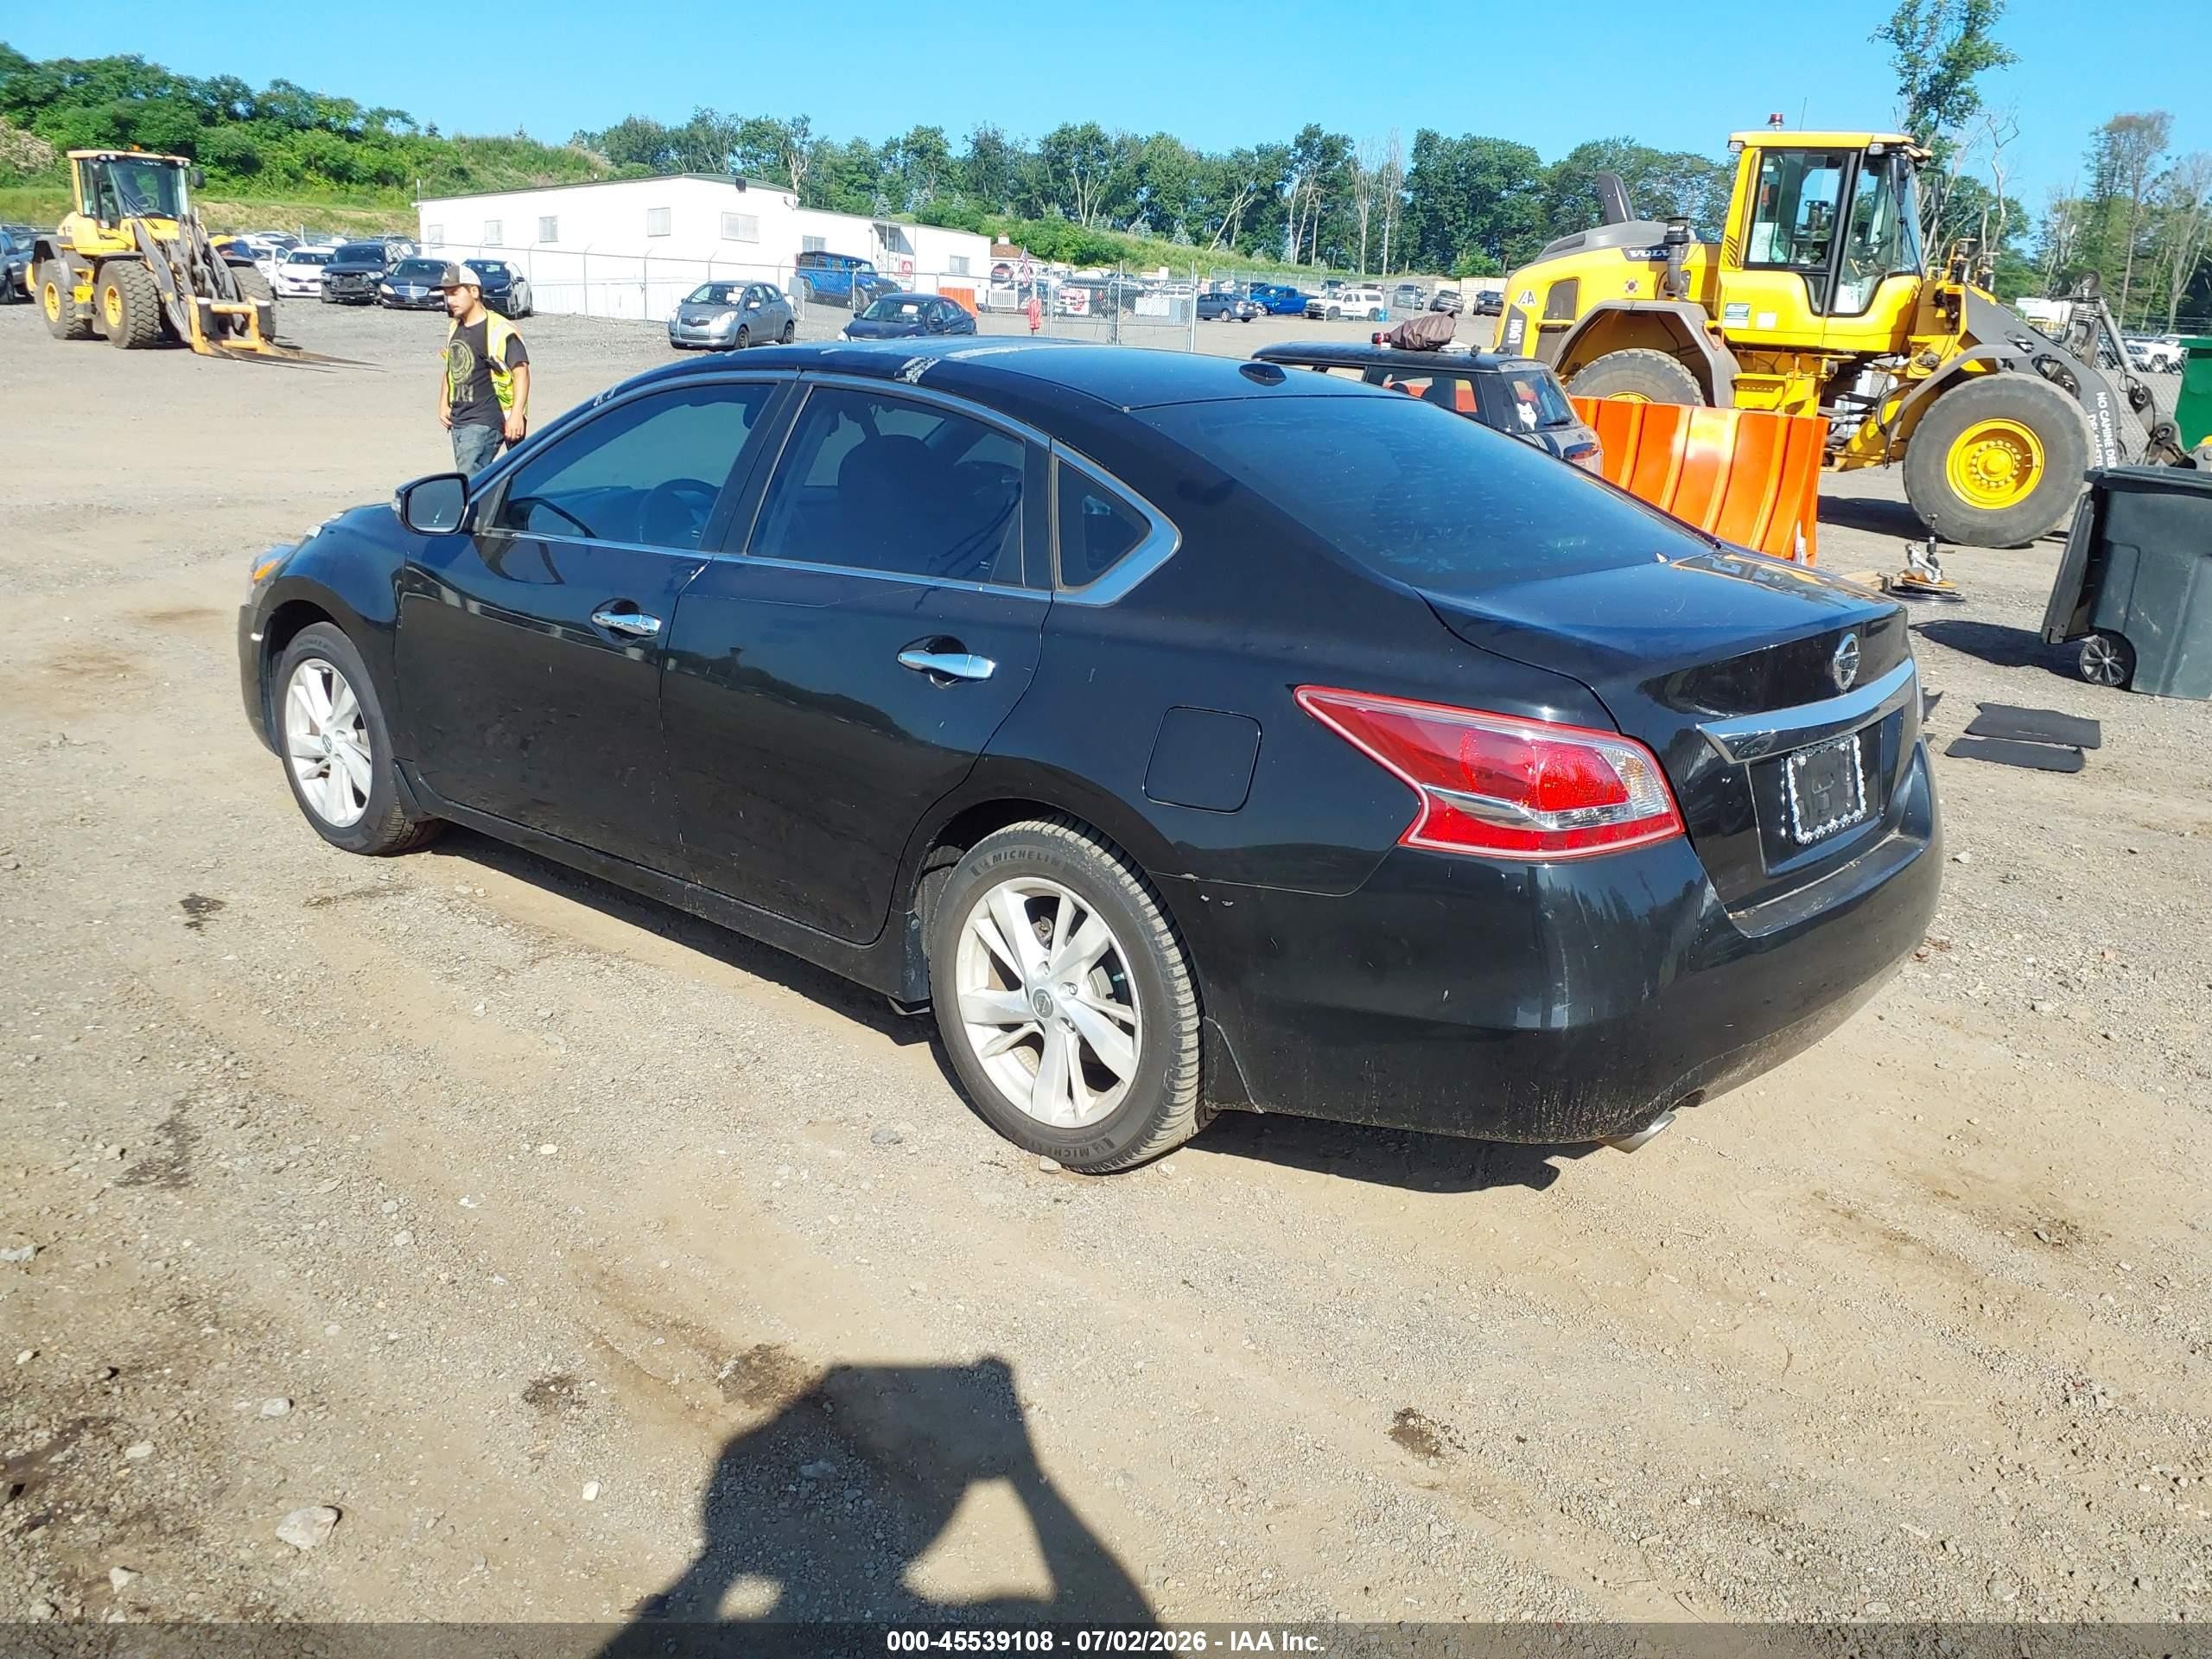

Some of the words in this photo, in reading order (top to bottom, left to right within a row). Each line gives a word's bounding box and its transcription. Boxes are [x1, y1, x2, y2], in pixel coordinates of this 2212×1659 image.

[1629, 249, 1670, 257] VOLV
[1508, 319, 1523, 344] L90H
[2095, 391, 2107, 409] NO
[2100, 410, 2114, 448] CAMINE
